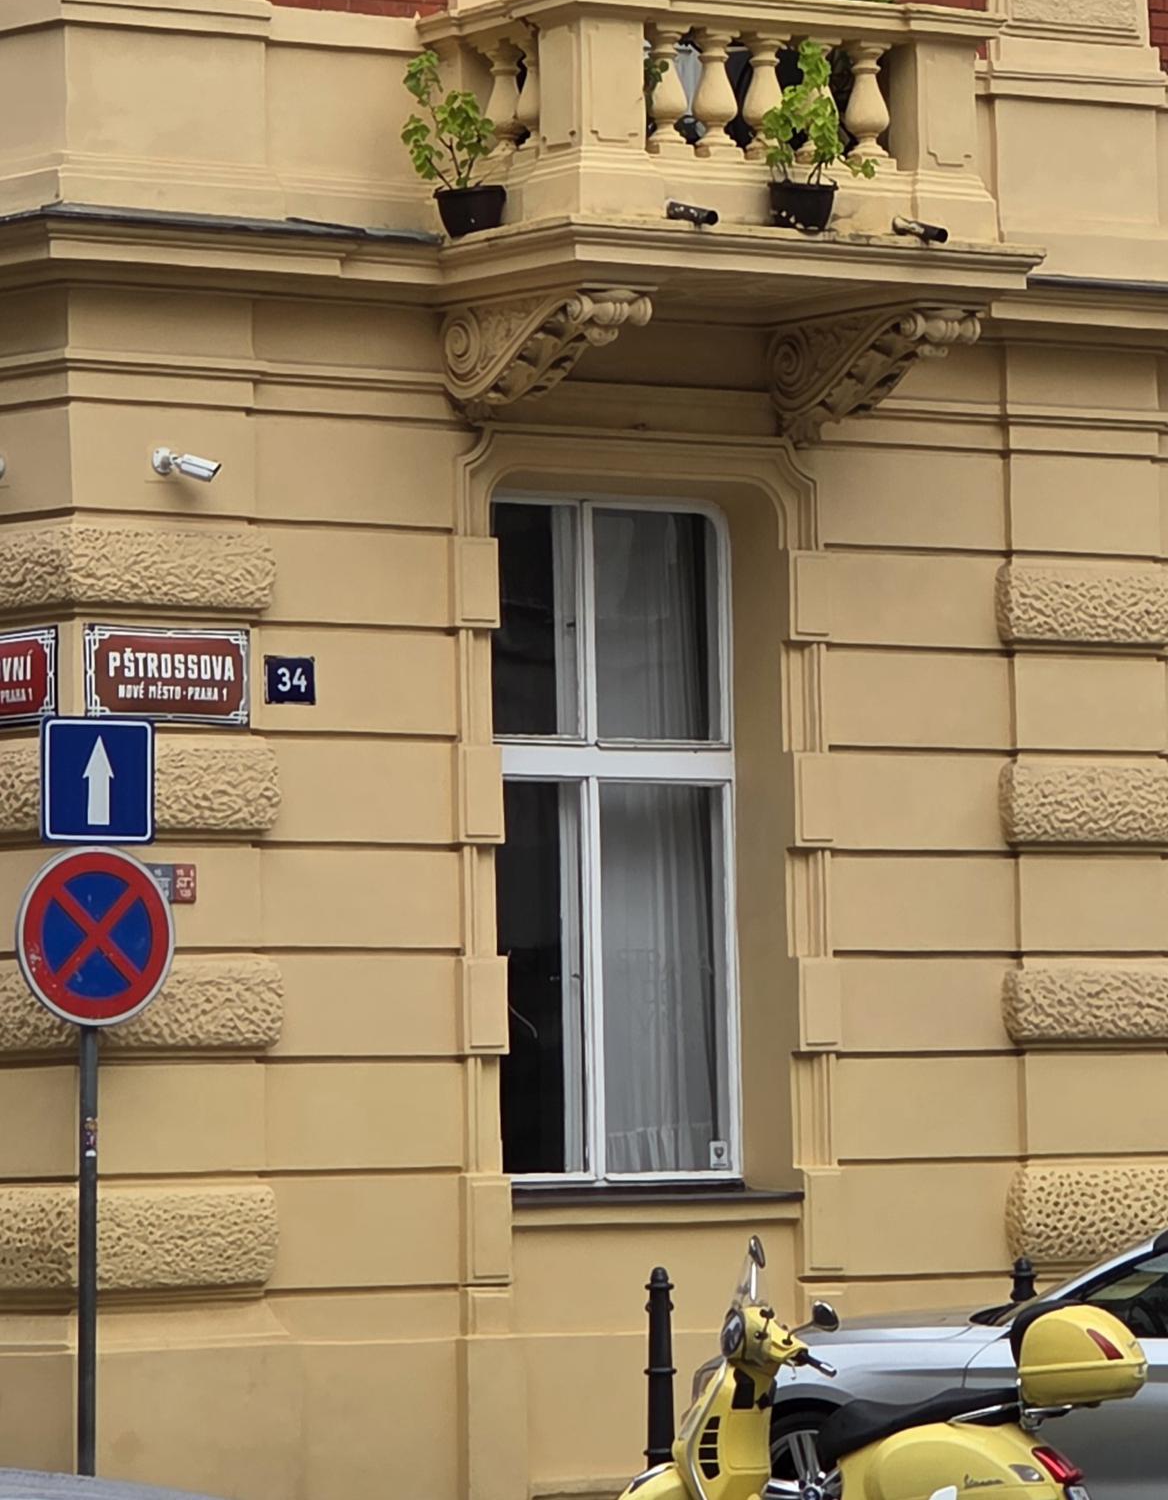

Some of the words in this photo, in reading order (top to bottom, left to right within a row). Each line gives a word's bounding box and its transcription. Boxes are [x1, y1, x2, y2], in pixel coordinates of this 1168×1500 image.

[0, 648, 34, 683] VNÍ
[108, 648, 235, 682] PŠTROSSOVA
[118, 682, 145, 699] NOVÉ
[149, 682, 182, 700] MĚSTO
[187, 687, 219, 701] PRAHA
[222, 687, 228, 702] 1
[276, 667, 308, 693] 34
[28, 687, 33, 701] 1
